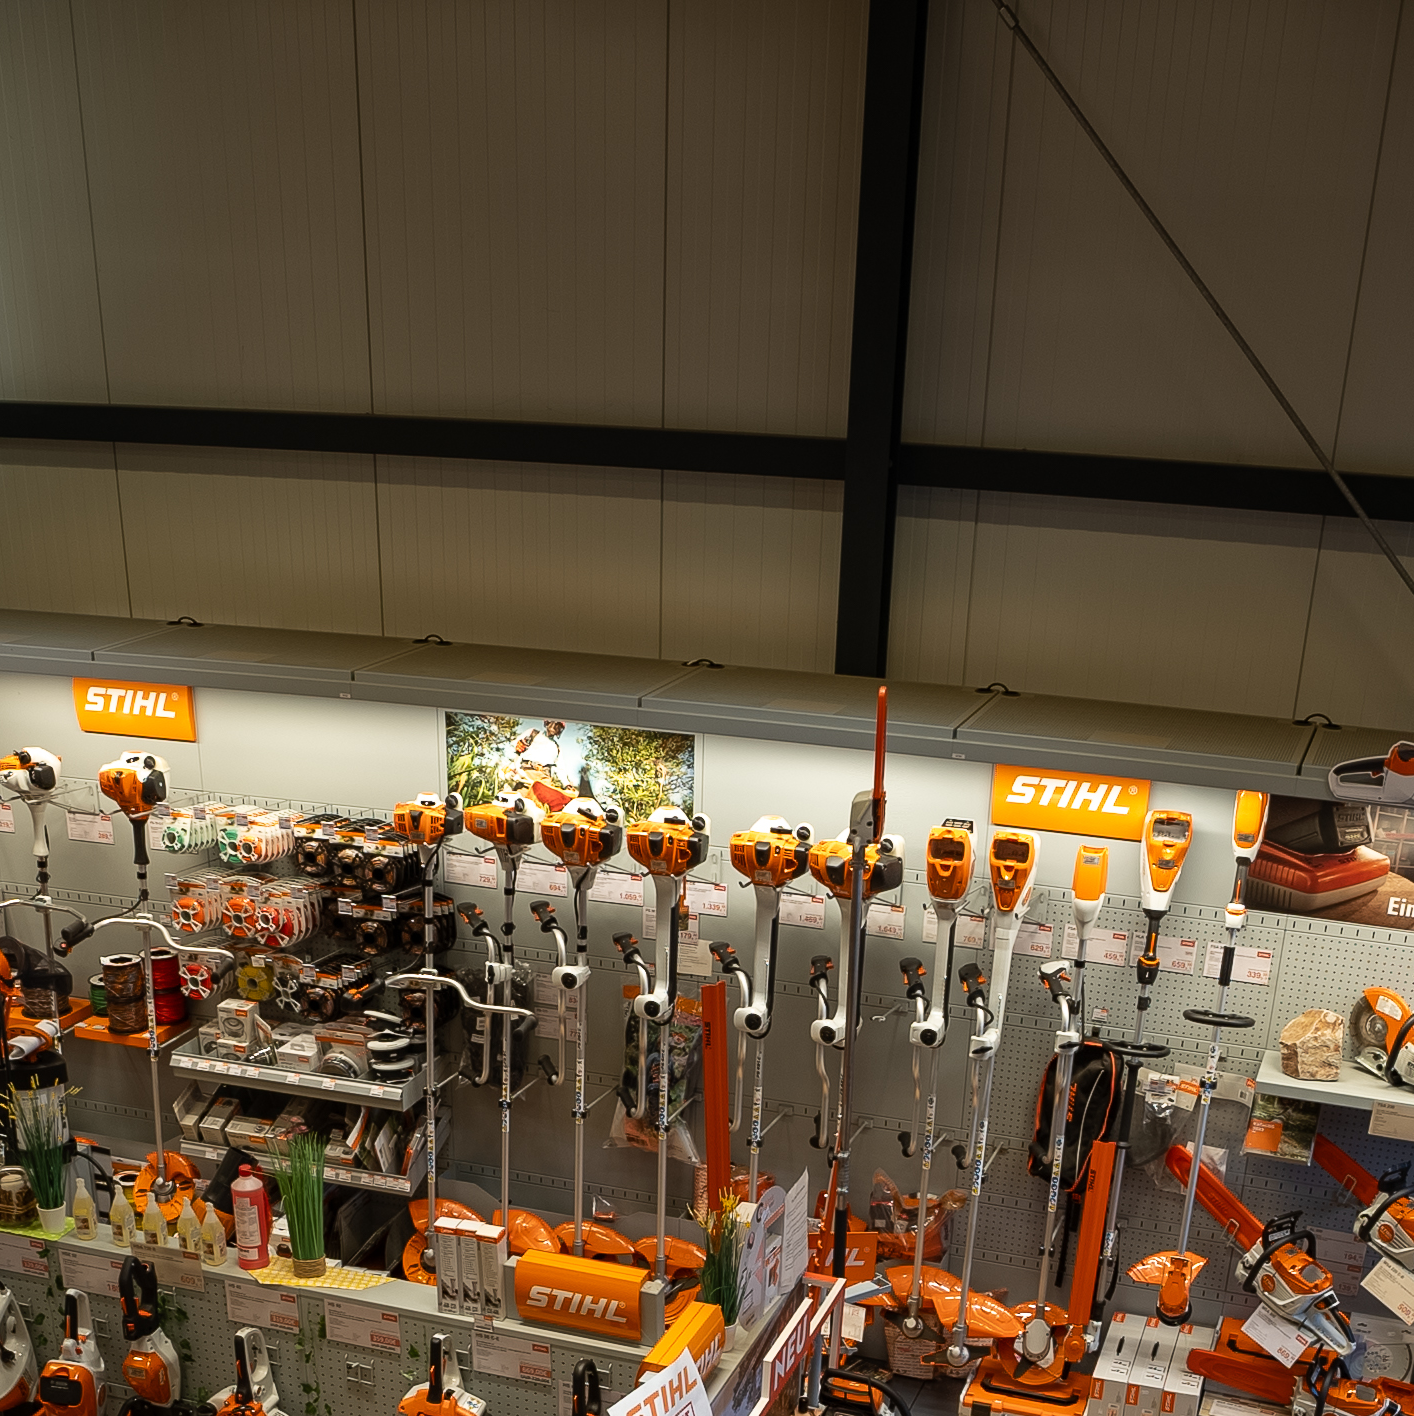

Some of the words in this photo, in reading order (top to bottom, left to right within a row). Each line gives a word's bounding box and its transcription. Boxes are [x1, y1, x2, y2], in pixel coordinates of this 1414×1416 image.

[84, 686, 176, 719] STIHL
[1005, 775, 1131, 816] STIHL
[526, 1285, 628, 1323] STIHL
[773, 1316, 809, 1392] NEU
